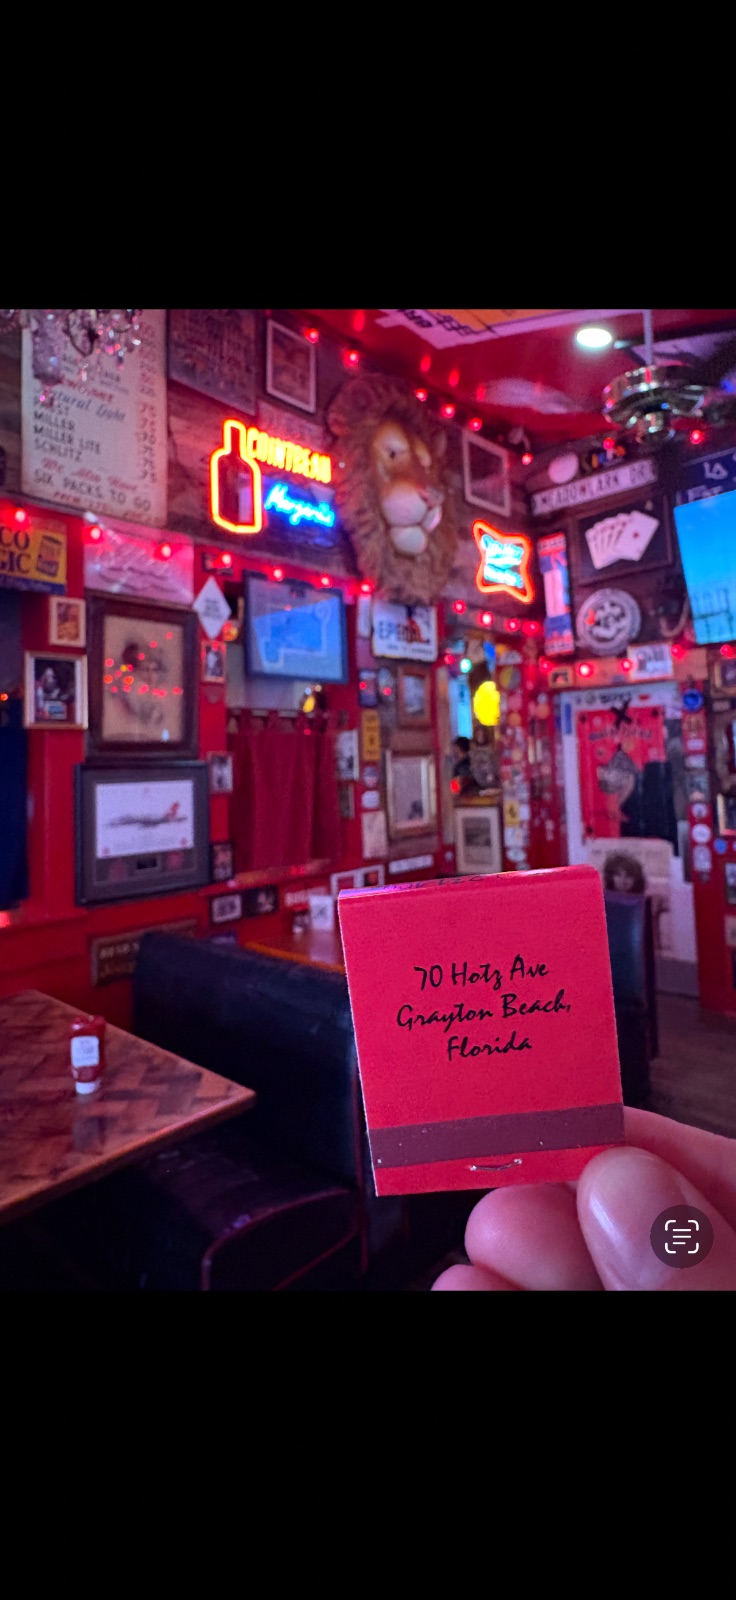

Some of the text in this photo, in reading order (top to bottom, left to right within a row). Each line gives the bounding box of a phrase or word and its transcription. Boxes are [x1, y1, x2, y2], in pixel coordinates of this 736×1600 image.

[33, 409, 75, 432] MILLER
[33, 424, 74, 445] MILLER
[33, 438, 82, 463] SCHLITZ
[63, 477, 104, 500] PACKS
[109, 488, 127, 506] TO
[413, 953, 550, 991] 70 Hotz Ave
[396, 988, 571, 1034] Grayton Beach,
[446, 1030, 533, 1062] Florida
